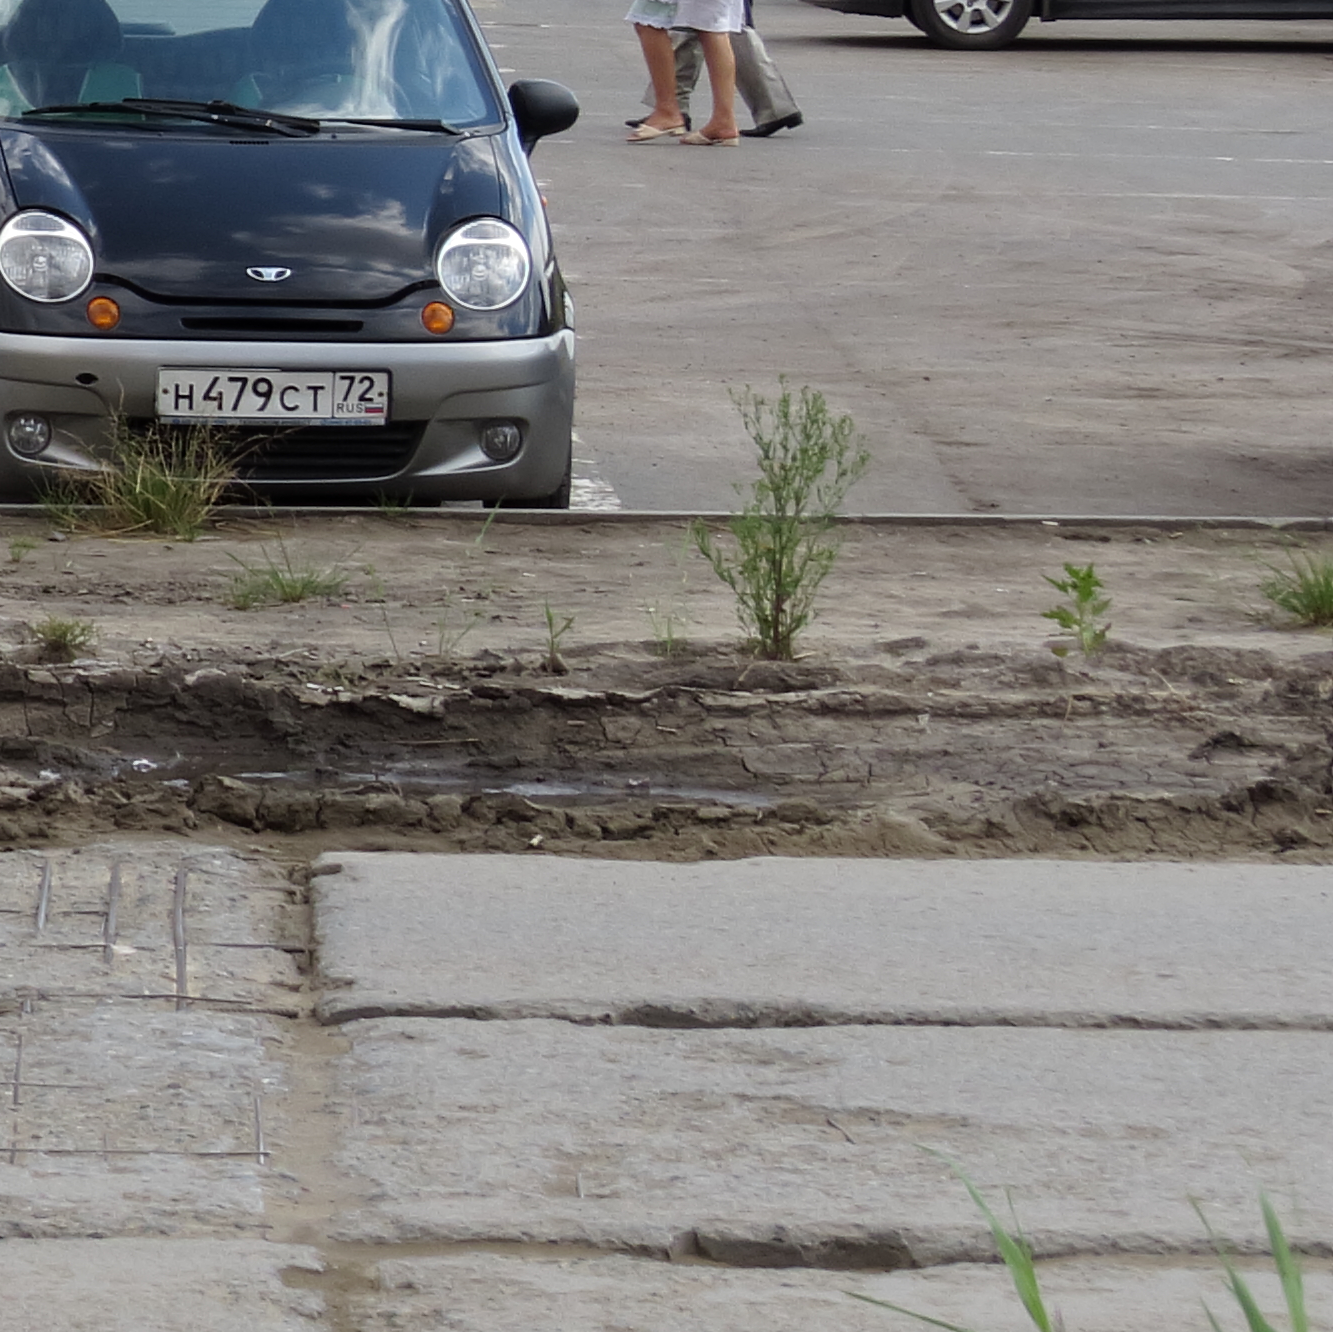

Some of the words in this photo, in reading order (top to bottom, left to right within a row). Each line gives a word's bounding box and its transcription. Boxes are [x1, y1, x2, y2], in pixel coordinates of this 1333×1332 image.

[173, 375, 326, 412] Н479СТ
[339, 375, 375, 402] 72
[336, 403, 364, 414] RUS
